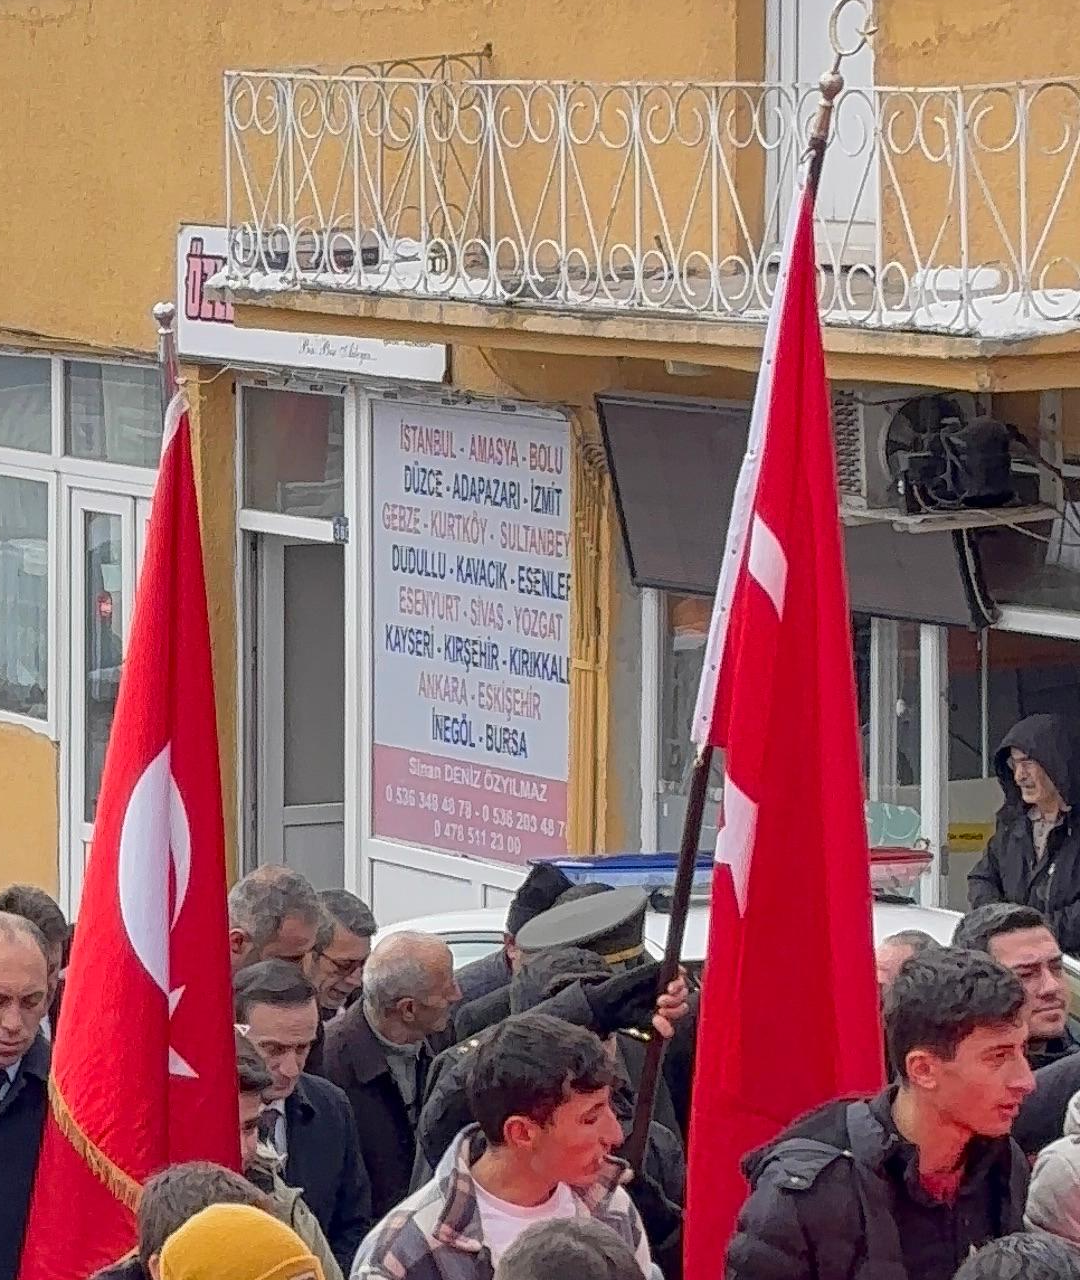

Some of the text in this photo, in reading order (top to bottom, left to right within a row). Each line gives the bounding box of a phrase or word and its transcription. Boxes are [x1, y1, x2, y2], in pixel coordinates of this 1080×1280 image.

[400, 419, 456, 458] İSTANBUL
[469, 434, 519, 468] AMASYA
[529, 442, 563, 474] BOLU
[404, 461, 443, 497] DÜZCE
[452, 473, 520, 510] ADAPAZARI
[531, 478, 562, 516] İZMİT
[382, 502, 421, 534] GEBZE
[431, 510, 487, 545] KURTKÖY
[392, 544, 446, 579] DUDULLU
[456, 555, 507, 590] KAVACIK
[399, 586, 461, 622] ESENYURT
[470, 595, 504, 631] SİVAS
[514, 606, 563, 641] YOZGAT
[385, 623, 434, 658] KAYSERİ
[444, 633, 500, 672] KIRŞEHİR
[418, 671, 468, 706] ANKARA
[478, 681, 541, 721] ESKİŞEHİR
[432, 706, 475, 748] İNEGÖL
[486, 723, 528, 759] BURSA
[445, 763, 481, 789] DENİZ
[484, 769, 548, 802] ÖZYILMAZ
